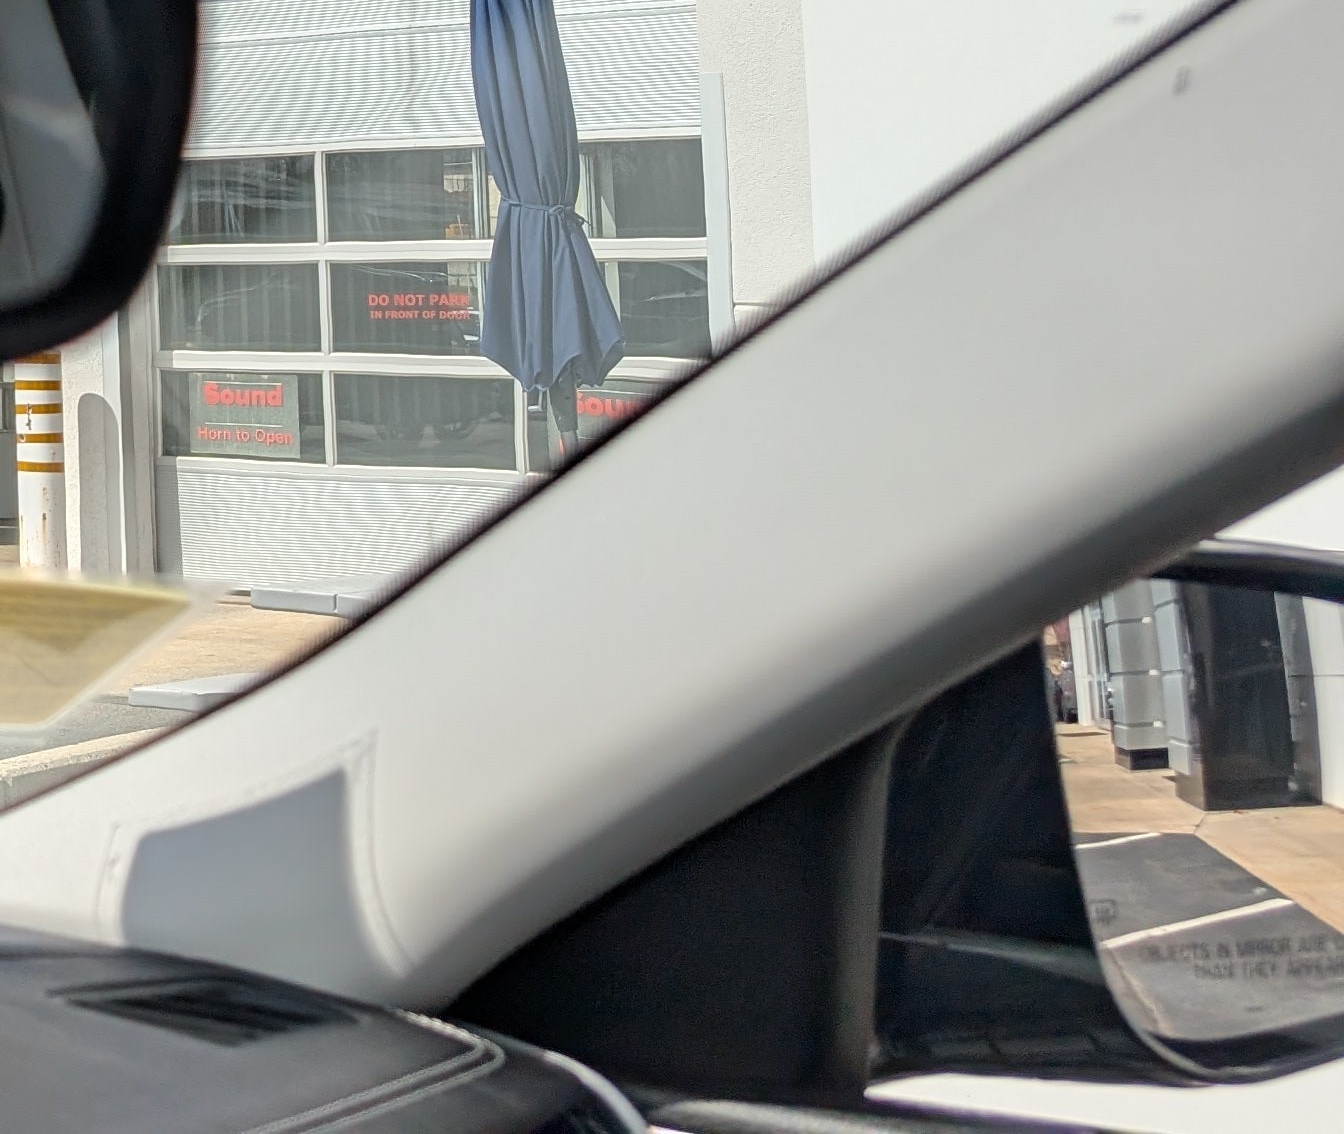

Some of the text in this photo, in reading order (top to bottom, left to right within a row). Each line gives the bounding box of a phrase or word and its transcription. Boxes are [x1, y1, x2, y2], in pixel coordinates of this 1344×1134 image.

[368, 294, 390, 306] DO
[394, 294, 425, 306] NOT
[370, 310, 471, 320] IN FRONT OF DOOR
[202, 381, 284, 406] Sound
[197, 427, 293, 446] Horn to Open
